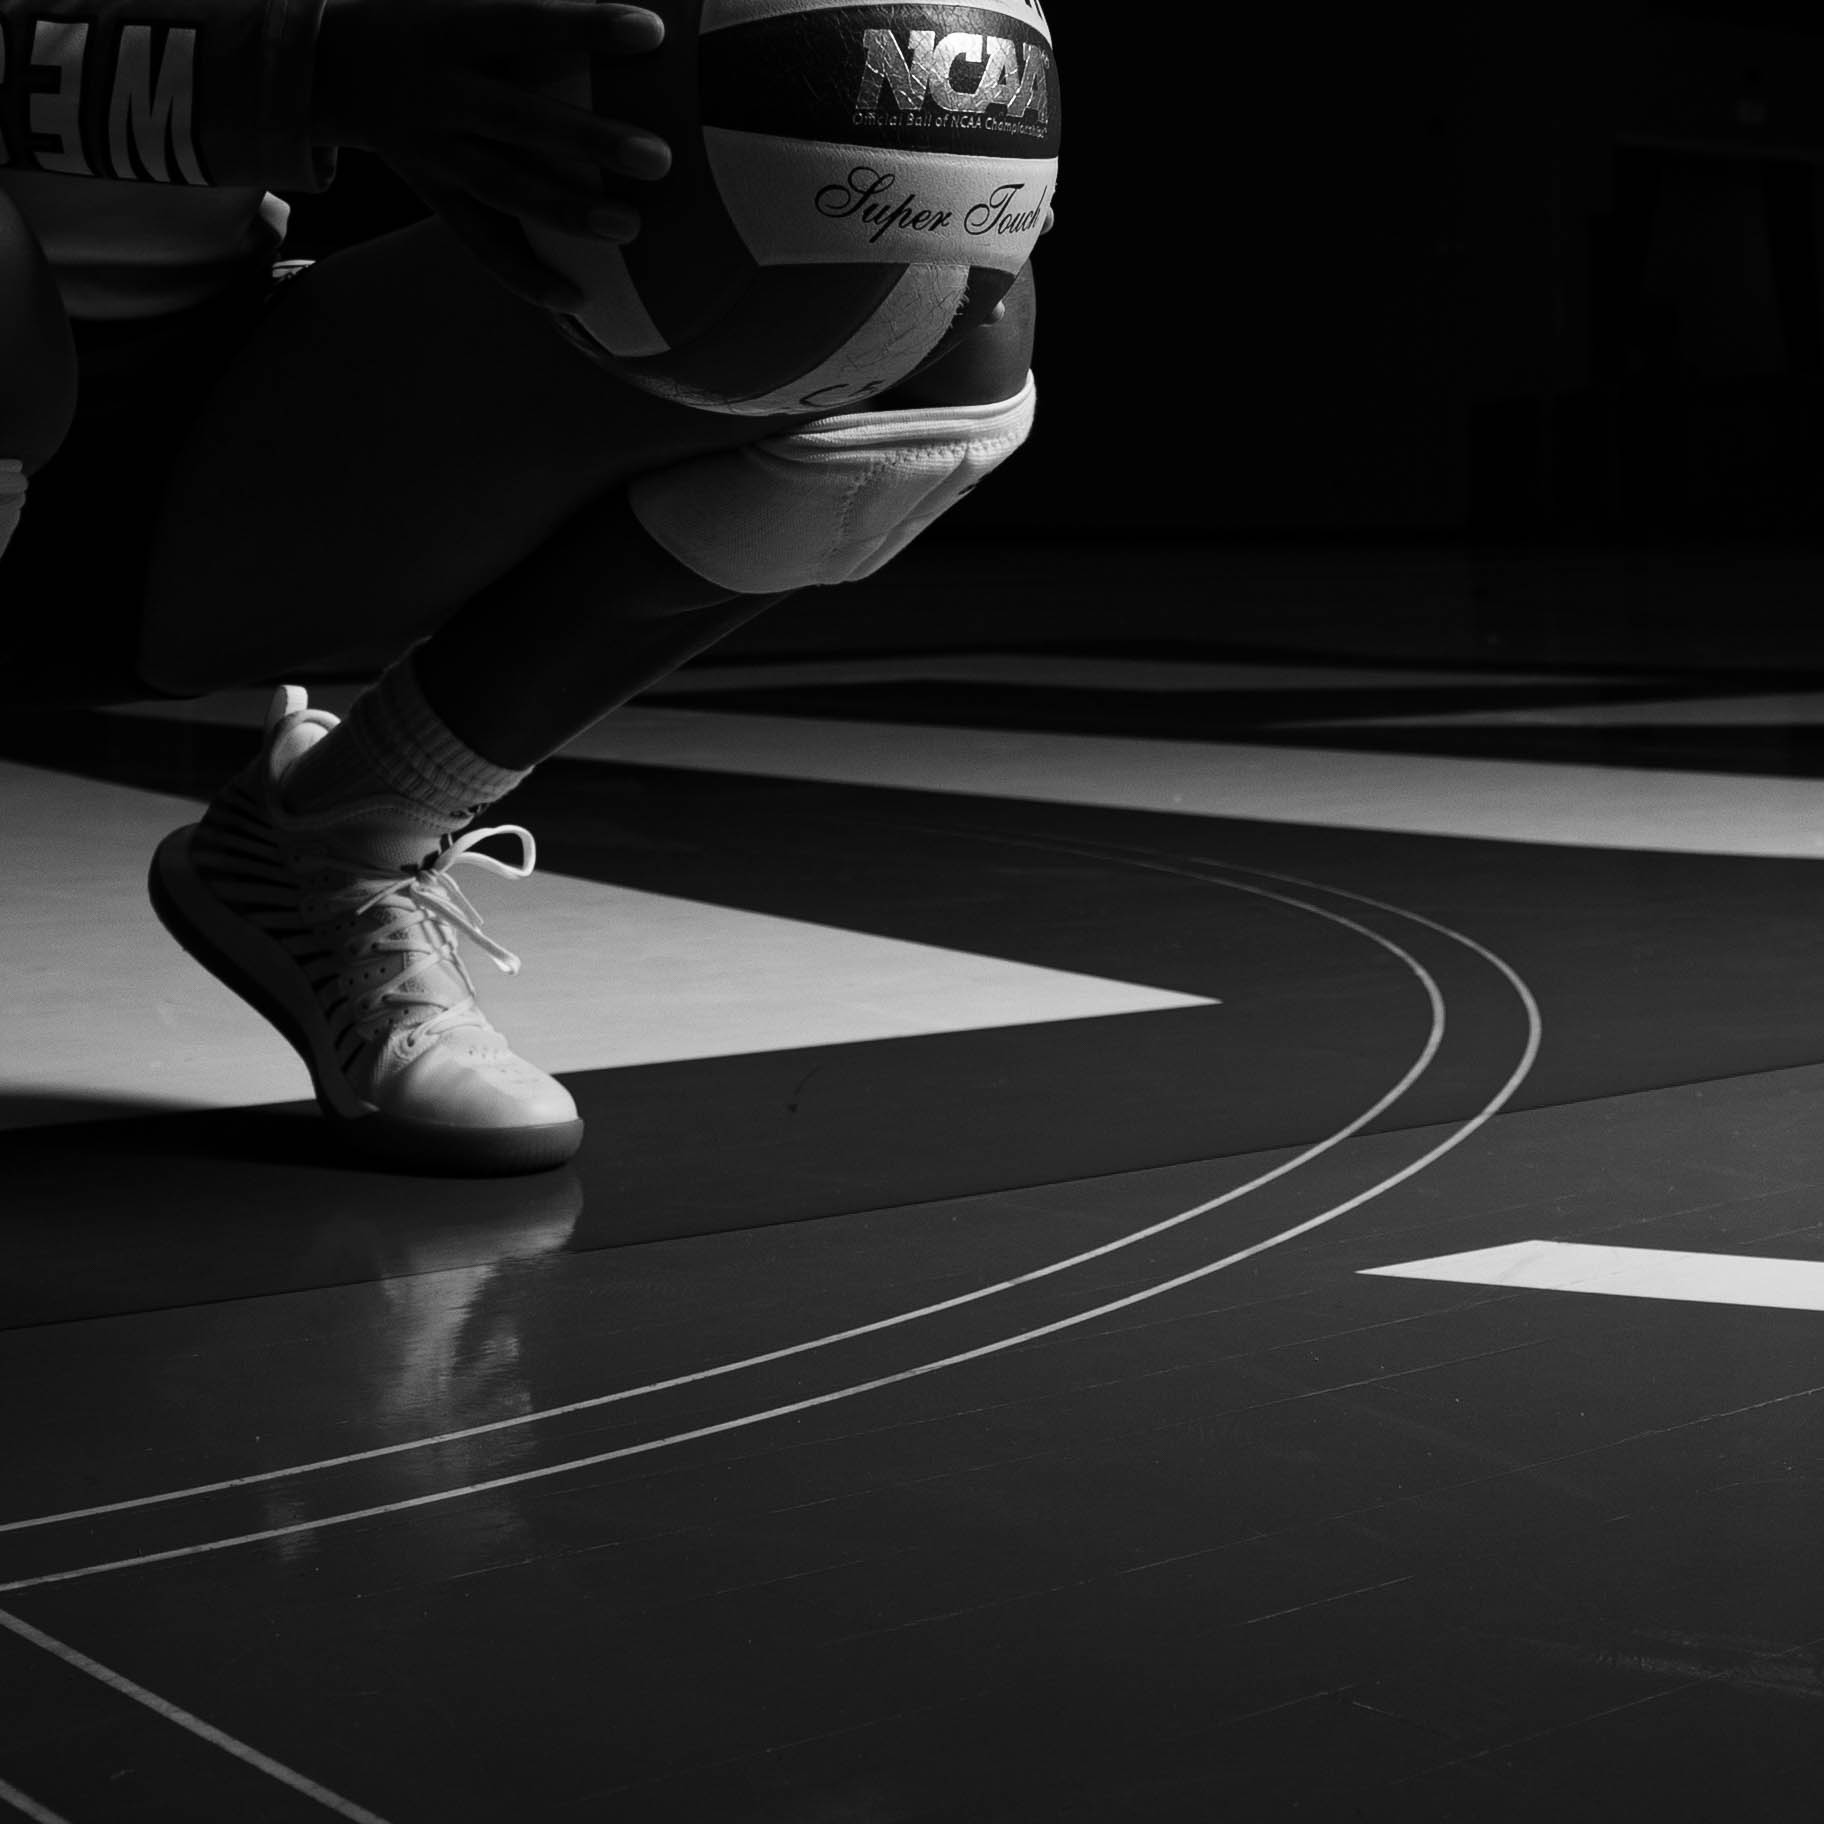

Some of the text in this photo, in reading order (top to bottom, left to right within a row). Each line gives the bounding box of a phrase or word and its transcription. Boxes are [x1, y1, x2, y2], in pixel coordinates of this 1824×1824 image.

[856, 28, 1049, 125] NCAA
[906, 113, 931, 127] Ball
[935, 114, 948, 128] of
[951, 114, 983, 129] NCAA
[814, 166, 1048, 244] Super Touch
